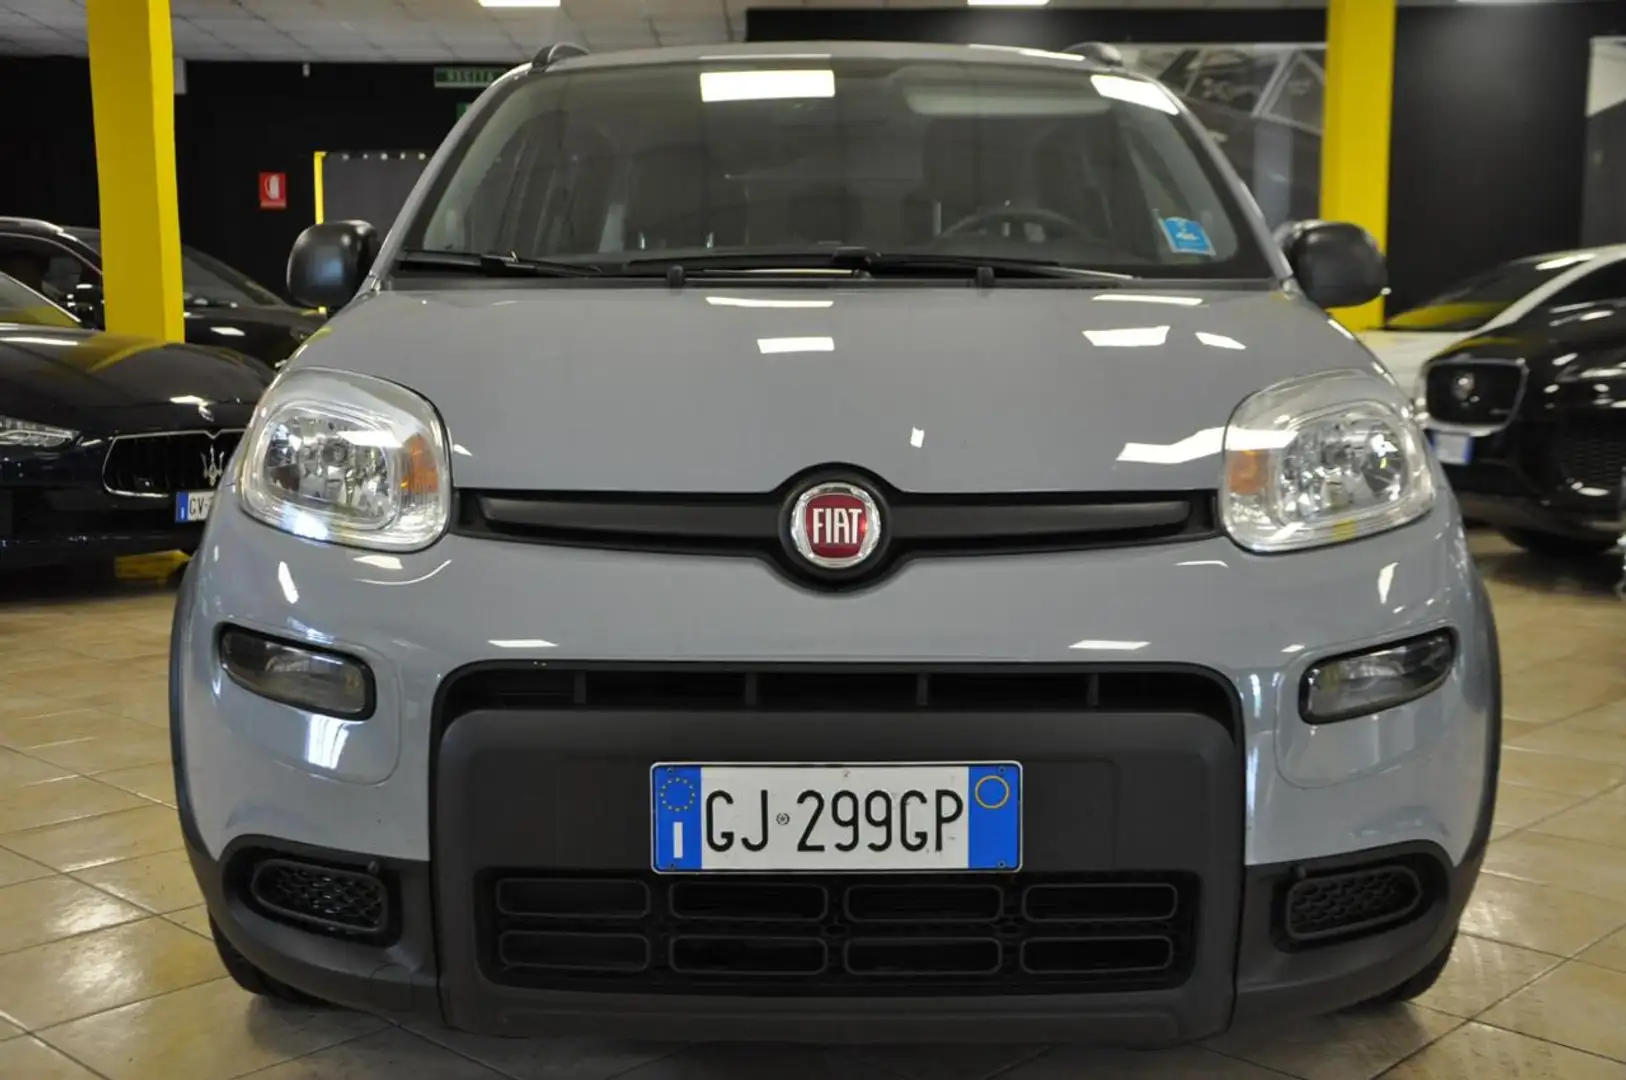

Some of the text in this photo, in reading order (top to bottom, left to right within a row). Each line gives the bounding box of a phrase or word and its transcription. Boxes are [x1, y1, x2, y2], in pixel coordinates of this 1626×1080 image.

[812, 507, 863, 544] FIAT
[705, 789, 964, 853] GJ 299GP
